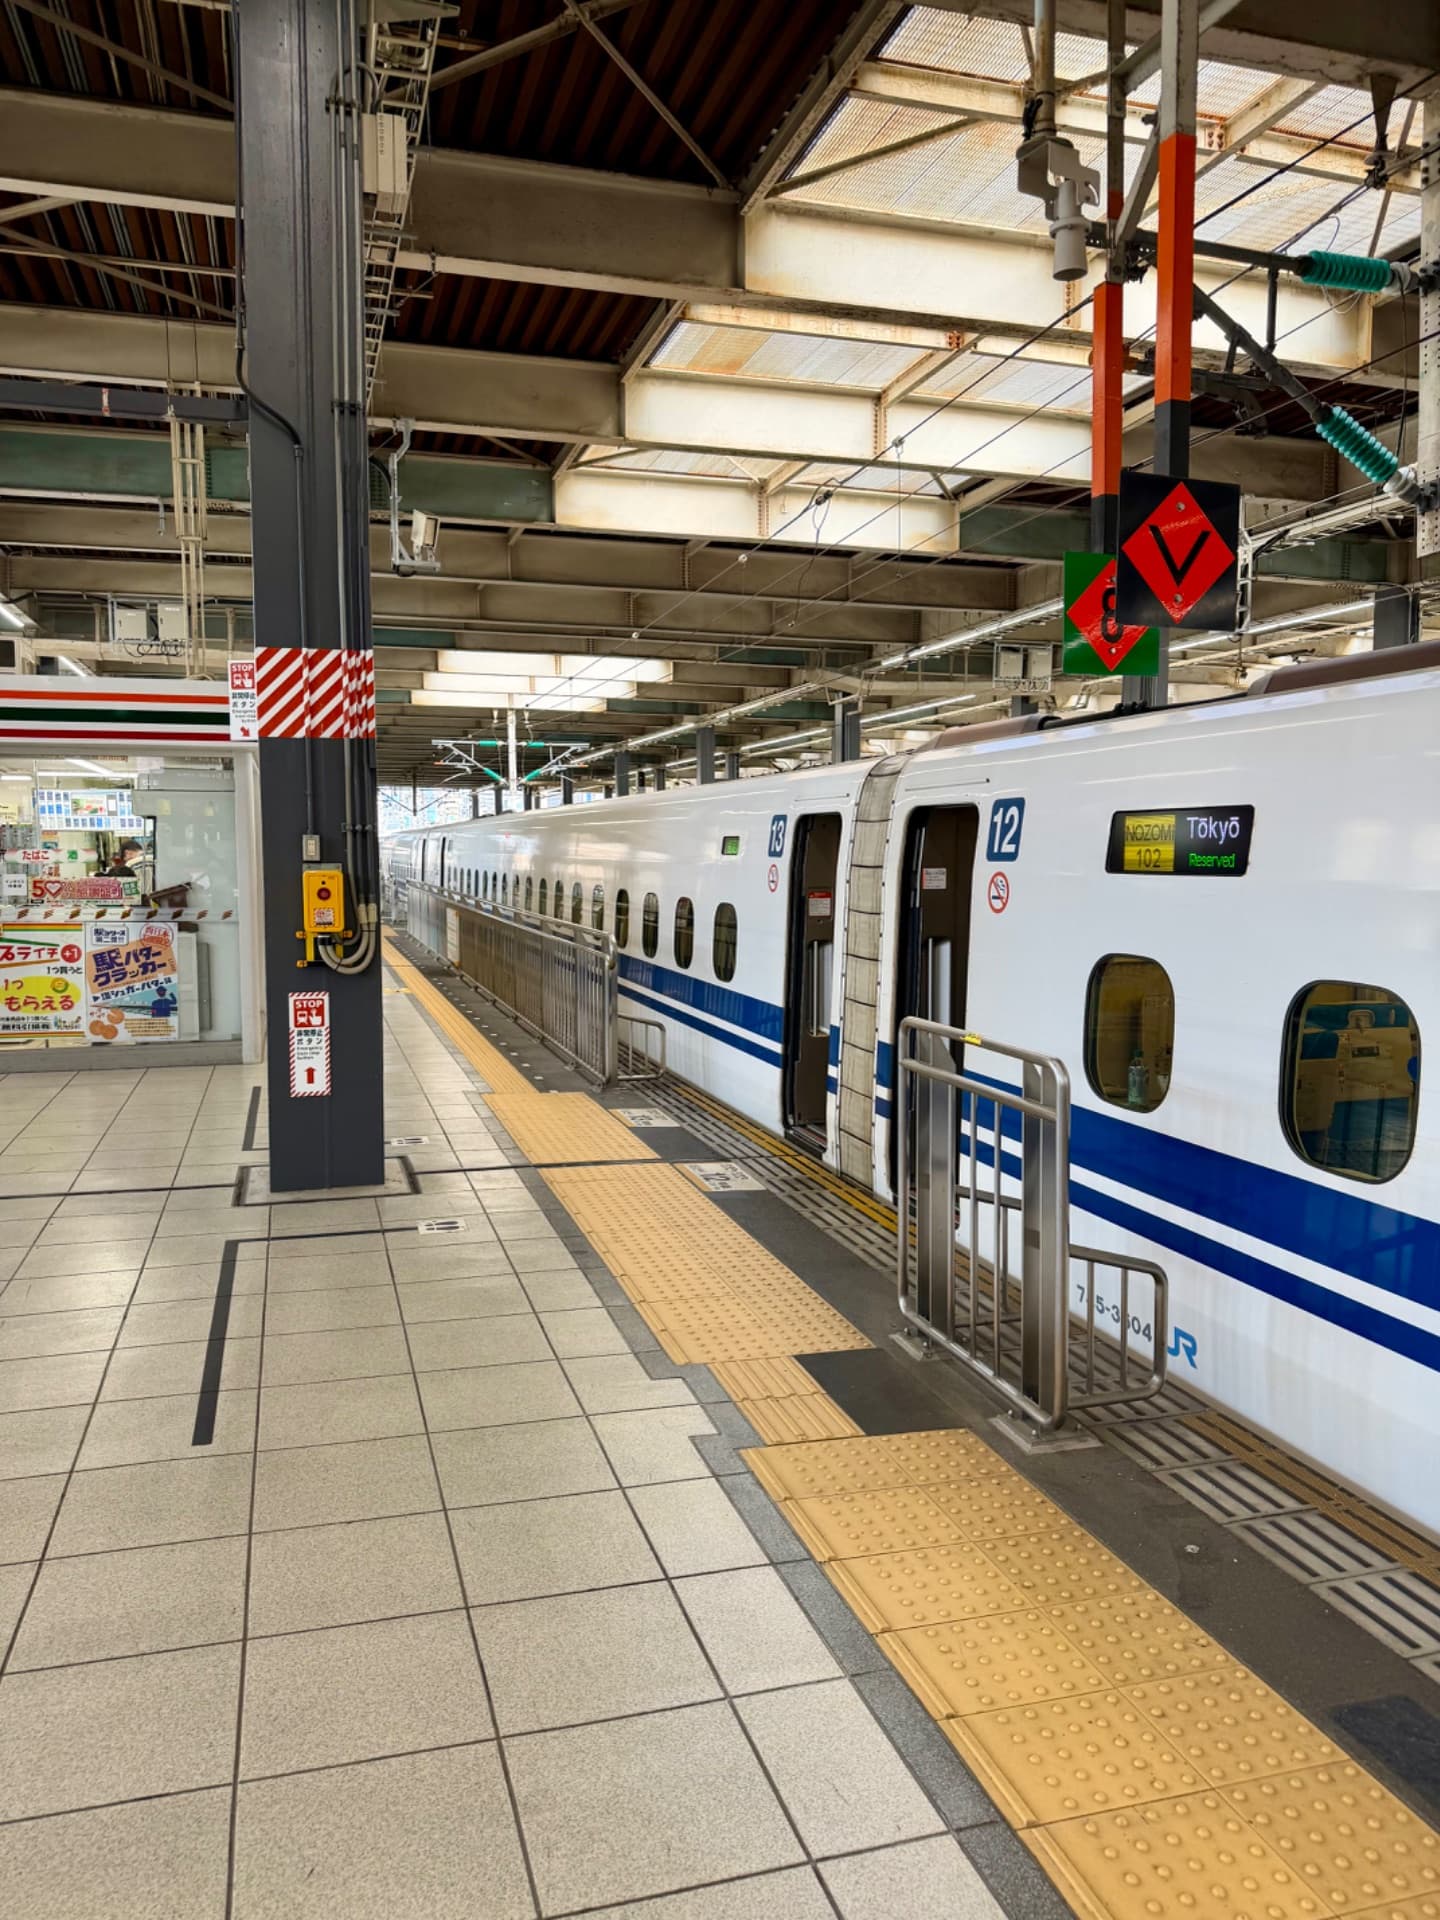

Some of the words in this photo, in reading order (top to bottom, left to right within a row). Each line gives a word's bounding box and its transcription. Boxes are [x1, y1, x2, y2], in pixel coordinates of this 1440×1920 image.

[232, 664, 254, 672] STOP
[770, 821, 783, 851] 13
[992, 806, 1018, 853] 12
[1187, 816, 1240, 845] Tōkyō
[22, 850, 49, 860] たばこ
[1137, 848, 1161, 868] 102
[1189, 853, 1235, 868] Reserved
[93, 946, 162, 973] 駅バター
[47, 966, 82, 974] 1つ買うと
[93, 961, 167, 987] クラッカー
[4, 979, 24, 991] 1つ
[5, 995, 75, 1012] もらえる
[296, 1000, 322, 1008] STOP
[1167, 1326, 1198, 1369] JR
